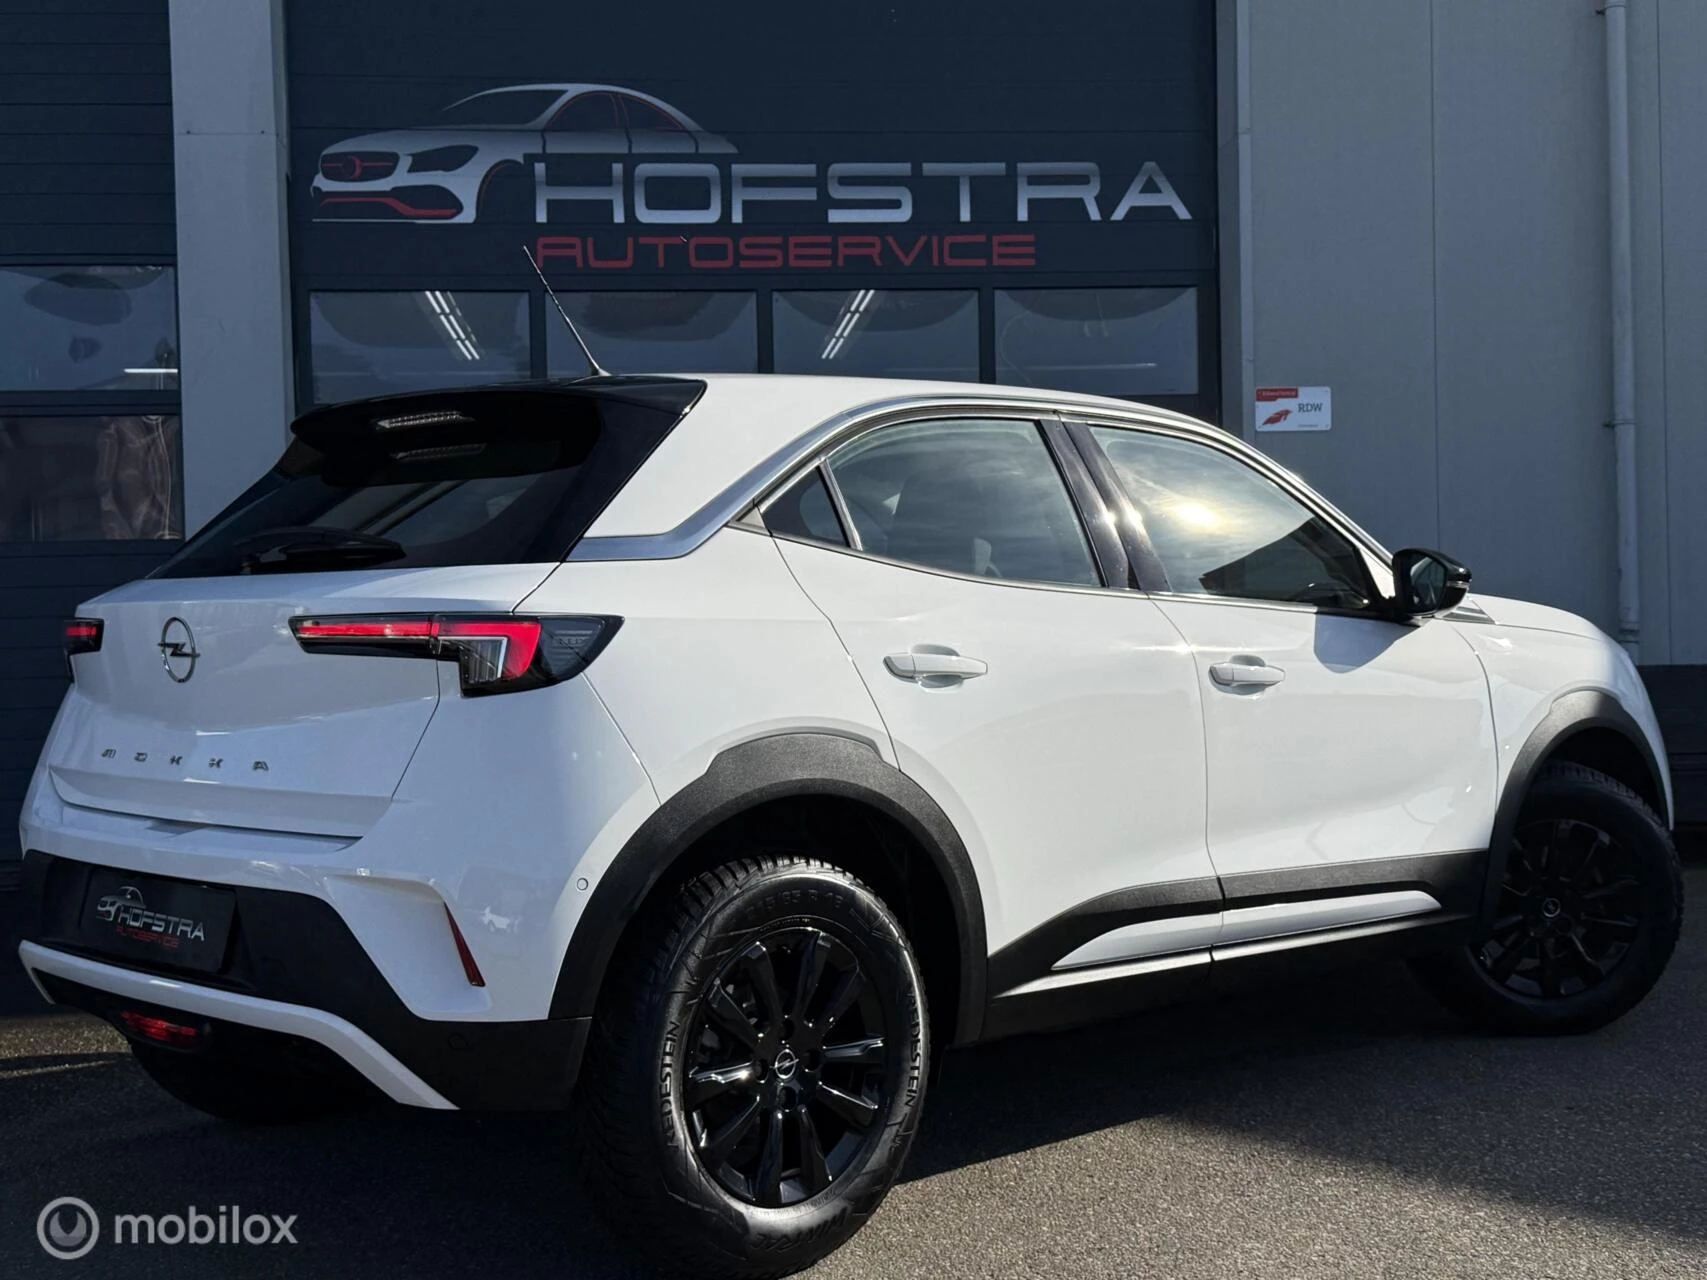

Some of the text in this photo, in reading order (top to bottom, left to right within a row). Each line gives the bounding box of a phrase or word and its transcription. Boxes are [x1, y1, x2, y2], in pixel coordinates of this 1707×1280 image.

[534, 161, 1193, 224] HOFSTRA
[536, 233, 1036, 269] AUTOSERVICE
[1298, 402, 1323, 413] RDW
[117, 905, 206, 942] HOFSTRA
